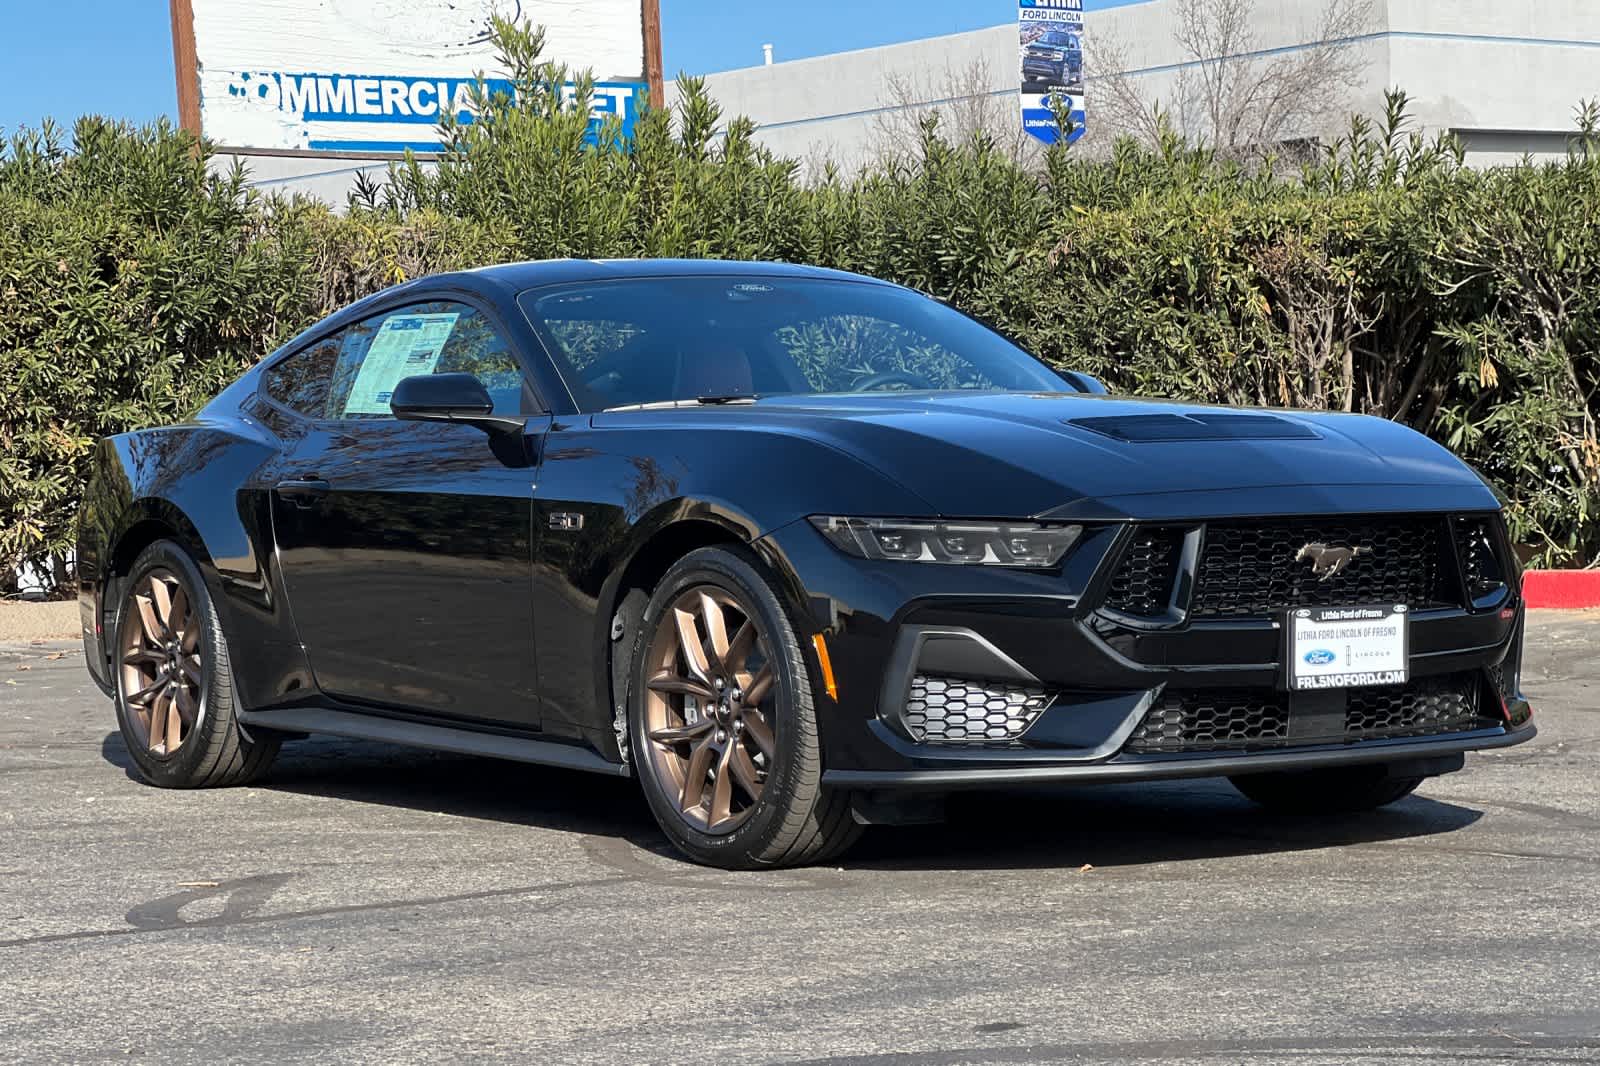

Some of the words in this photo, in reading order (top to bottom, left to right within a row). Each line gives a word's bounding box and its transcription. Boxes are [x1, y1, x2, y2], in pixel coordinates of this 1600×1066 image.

[1022, 10, 1047, 19] FORD
[1049, 11, 1081, 21] LINCOLN
[1321, 610, 1340, 620] Lithia
[1340, 609, 1354, 619] Ford
[1355, 609, 1361, 618] of
[1361, 609, 1383, 618] Fresno
[1297, 630, 1317, 641] LITHIA
[1318, 629, 1335, 640] FORD
[1336, 627, 1362, 639] LINCOLN
[1363, 627, 1371, 638] OF
[1372, 626, 1397, 637] FRESNO
